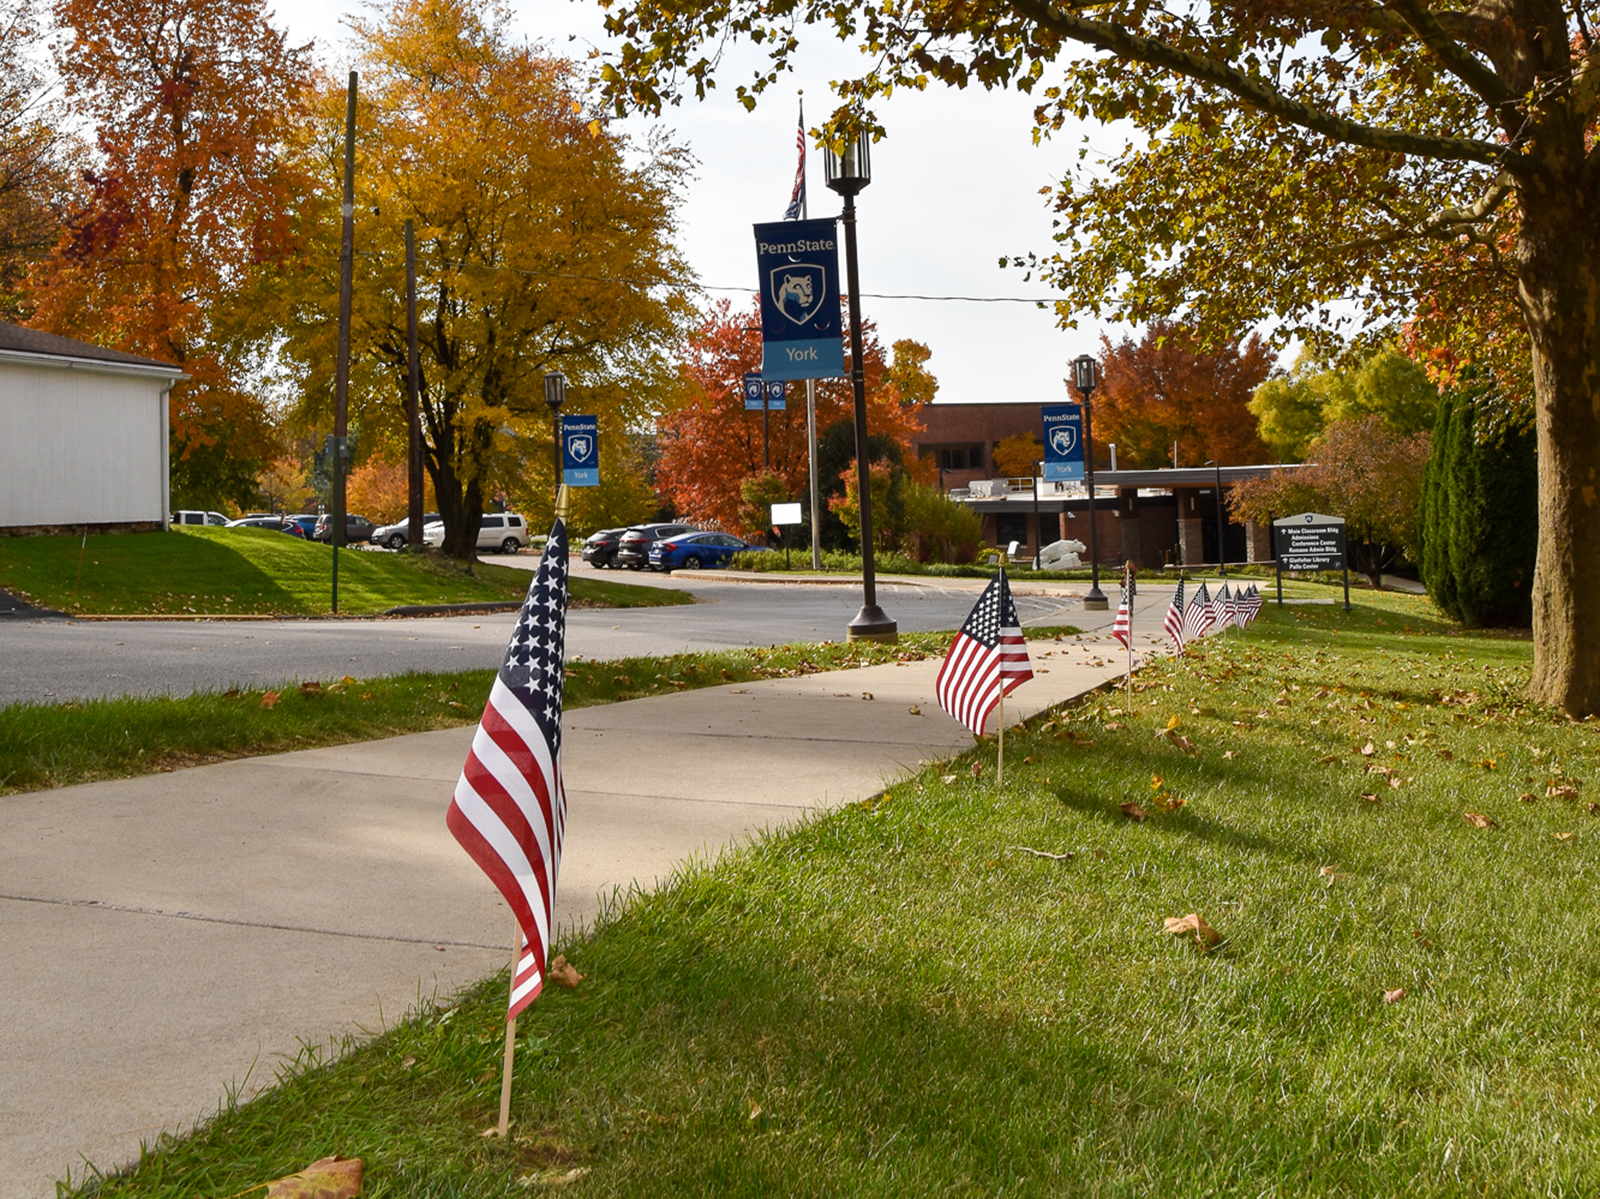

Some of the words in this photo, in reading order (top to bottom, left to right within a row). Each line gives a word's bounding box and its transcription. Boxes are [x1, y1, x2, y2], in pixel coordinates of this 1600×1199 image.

[759, 239, 834, 255] PennState
[786, 346, 818, 361] York
[1044, 414, 1080, 422] PennState
